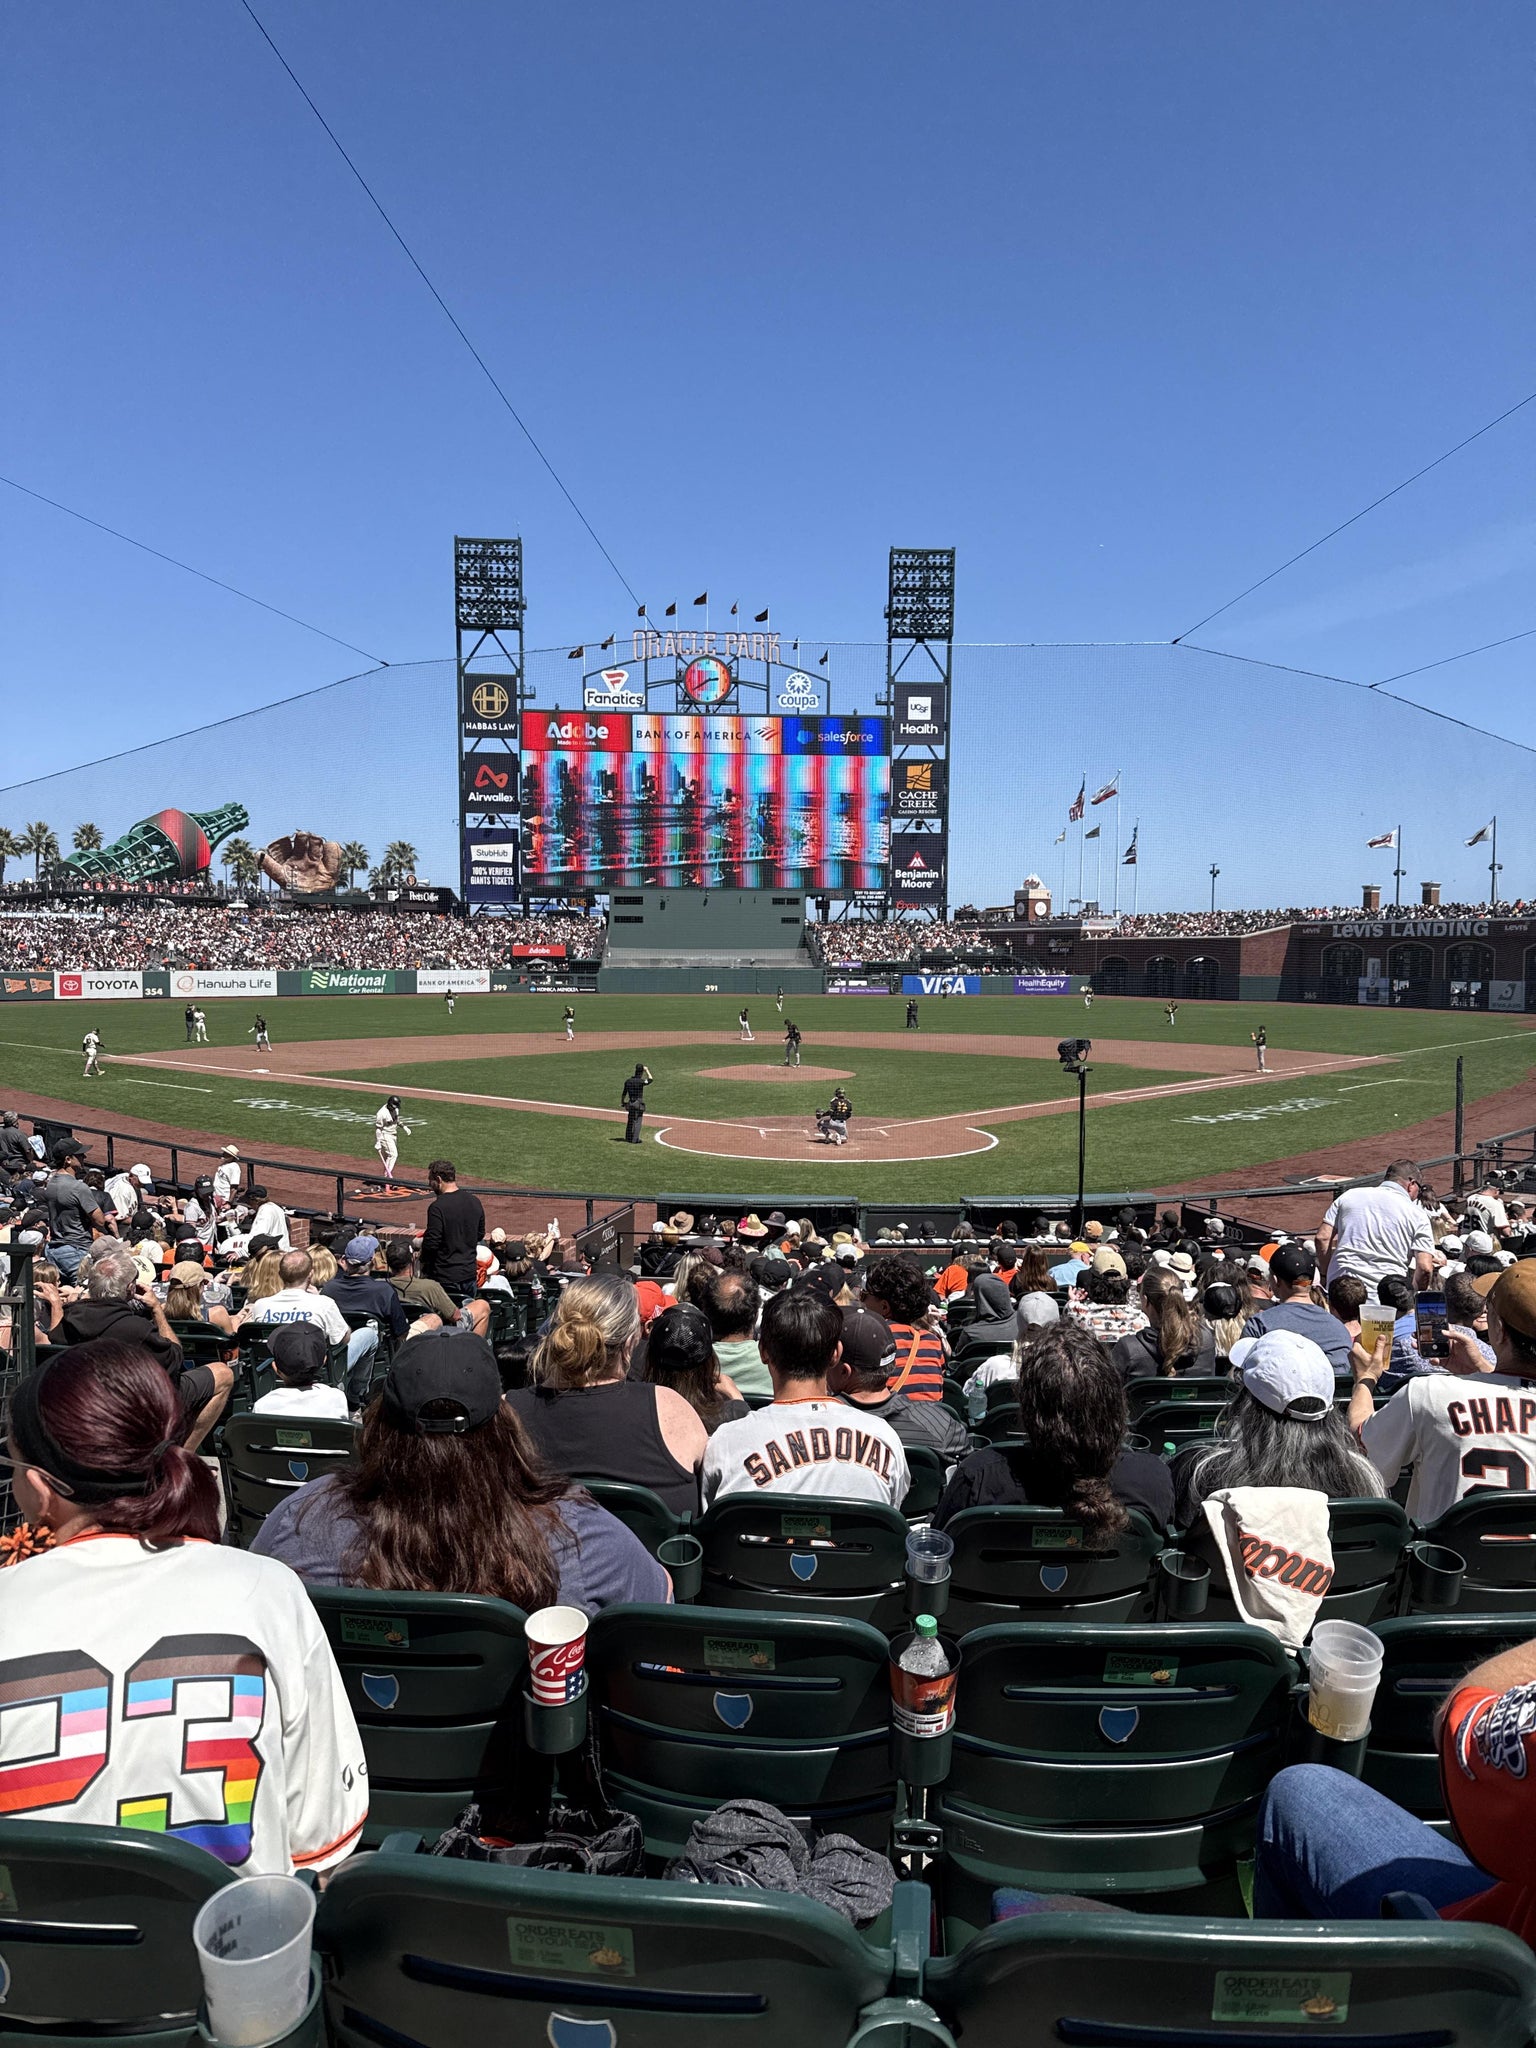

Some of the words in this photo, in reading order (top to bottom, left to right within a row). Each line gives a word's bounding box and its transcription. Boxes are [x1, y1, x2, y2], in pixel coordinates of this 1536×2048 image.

[633, 630, 716, 661] ORACLE
[725, 633, 781, 664] PARK
[587, 691, 643, 705] Fanatics
[780, 696, 816, 708] coupa
[910, 704, 928, 713] UCSF
[466, 722, 497, 730] HABBAS
[546, 722, 609, 739] Adobe
[900, 723, 938, 734] Health
[636, 730, 670, 739] BANK
[675, 731, 690, 739] OF
[694, 731, 751, 740] AMERICA
[818, 731, 873, 744] salesforce
[468, 792, 514, 802] Airwallex
[898, 791, 938, 799] CACHE
[899, 800, 937, 808] CREEK
[476, 849, 508, 857] StubHub
[472, 867, 488, 875] 100%
[489, 867, 513, 876] VERIFIED
[895, 869, 939, 880] Benjamin
[470, 876, 491, 885] GIANTS
[492, 876, 514, 885] TICKETS
[901, 879, 932, 888] Moore
[1391, 921, 1489, 937] LANDING
[87, 980, 138, 989] TOYOTA
[197, 979, 246, 989] Hanwha
[250, 979, 272, 988] Life
[328, 974, 386, 987] National
[917, 977, 966, 994] VISA
[1018, 979, 1066, 988] HealthEquity
[262, 1307, 312, 1323] Aspire
[1446, 1397, 1536, 1438] CHAP
[743, 1426, 890, 1488] SANDOVAL
[515, 1923, 566, 1938] ORDER
[568, 1928, 605, 1942] EATS
[519, 1935, 533, 1944] TO
[538, 1936, 573, 1948] YOUR
[1224, 1976, 1279, 1988] ORDER
[1282, 1977, 1321, 1989] EATS
[1226, 1987, 1242, 1997] TO
[1248, 1988, 1282, 1998] YOUR
